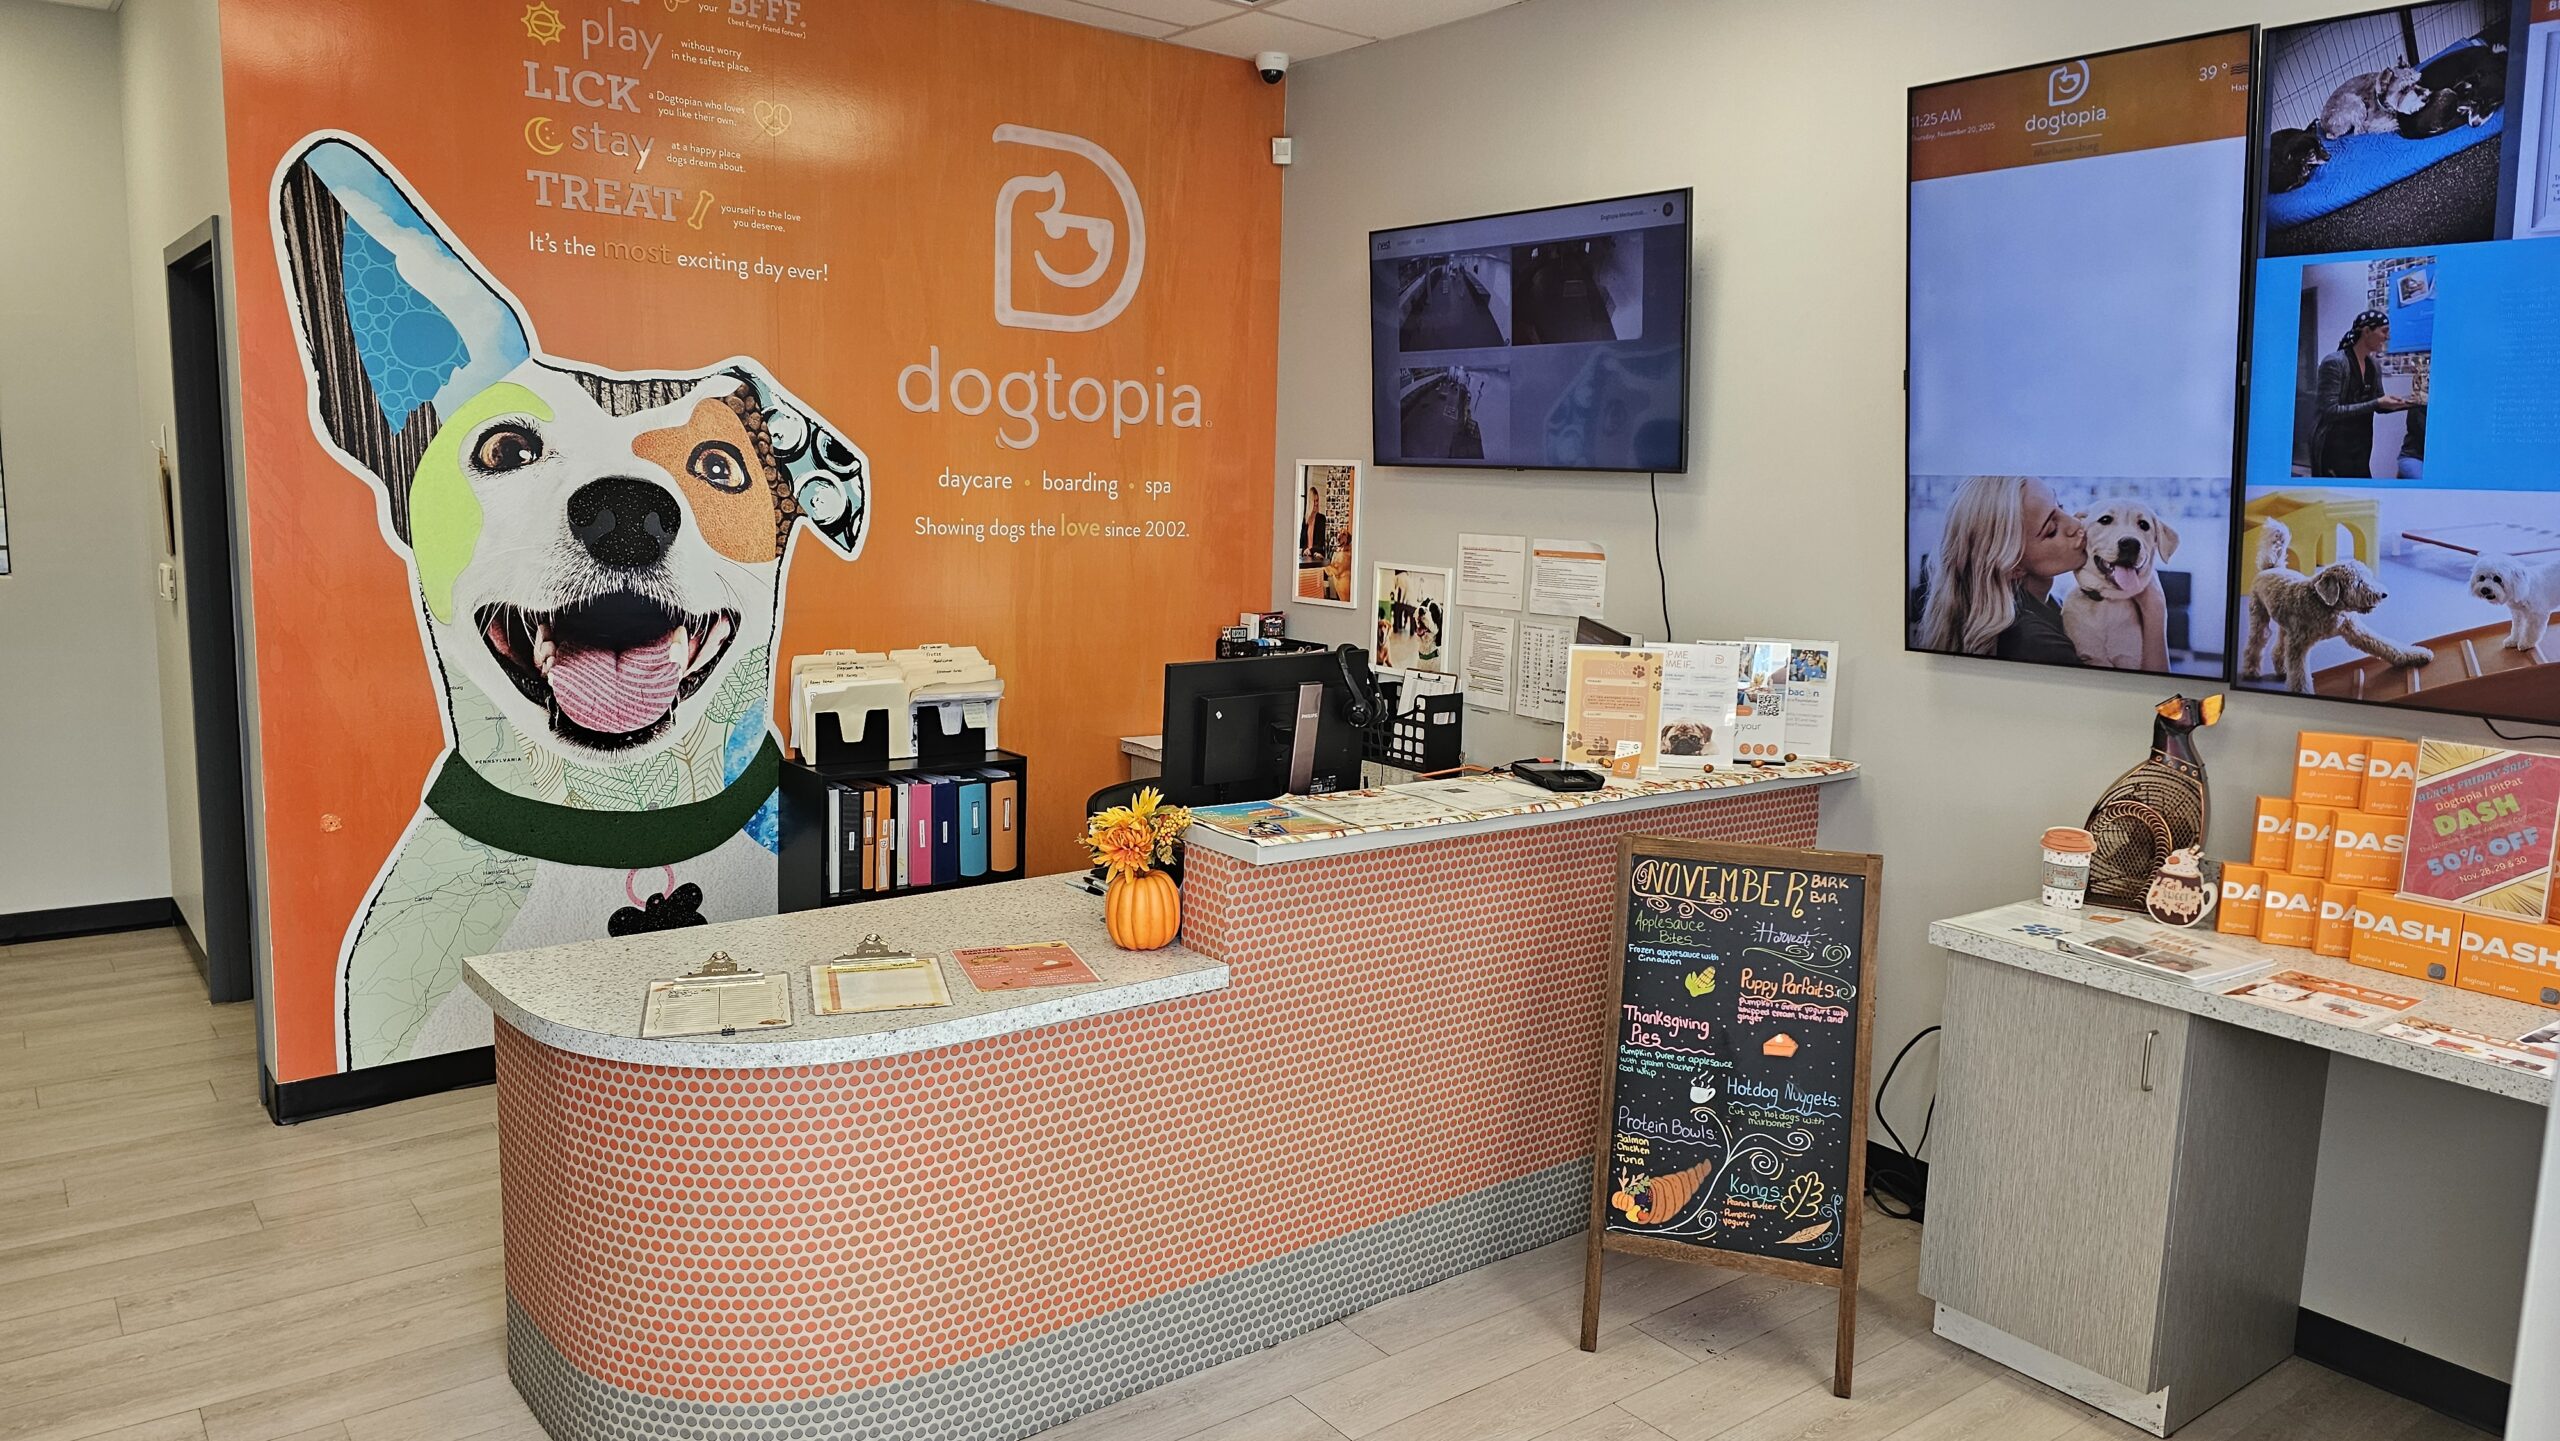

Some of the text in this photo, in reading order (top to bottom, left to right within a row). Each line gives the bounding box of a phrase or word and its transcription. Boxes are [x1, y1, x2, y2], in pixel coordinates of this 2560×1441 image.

[699, 3, 718, 13] your
[745, 20, 761, 32] furry
[762, 24, 781, 35] friend
[581, 8, 663, 70] play
[681, 39, 742, 60] without worry
[671, 50, 752, 73] in the safest place.
[523, 60, 641, 114] LICK
[656, 90, 703, 108] Dogtopian
[704, 100, 722, 110] who
[724, 102, 745, 114] loves
[658, 107, 737, 127] you like their own.
[1912, 108, 1962, 128] 11:25 AM
[2025, 105, 2107, 136] dogtopia
[571, 121, 655, 173] stay
[671, 142, 681, 151] at
[690, 143, 717, 157] happy
[718, 148, 741, 160] place
[666, 153, 747, 173] dogs dream about.
[526, 169, 683, 223] TREAT
[721, 204, 801, 221] yourself to the love
[733, 219, 786, 232] you deserve.
[529, 231, 829, 283] It's the most exciting day ever!
[897, 345, 1202, 449] dogtopia
[938, 466, 1171, 501] daycare boarding spa
[914, 513, 1190, 543] Showing dogs the love since 2002.
[1675, 651, 1689, 659] ME
[1741, 723, 1761, 731] your
[475, 757, 522, 765] PENNSYLVANIA
[2298, 748, 2366, 773] DAS
[2368, 758, 2416, 780] DA
[2417, 758, 2533, 803] BLACK FRIDAY SALE
[2435, 790, 2483, 812] Dogtopia
[2490, 777, 2523, 794] PitPat
[2257, 815, 2292, 834] DA
[2432, 793, 2521, 837] DASH
[2294, 821, 2331, 841] DA
[2334, 829, 2405, 853] DAS
[2426, 826, 2539, 877] 50% OFF
[2459, 872, 2479, 884] Nov.
[2508, 859, 2515, 868] &
[2515, 856, 2528, 866] 30
[1640, 861, 1849, 919] NOVEMBER BARK
[1809, 891, 1839, 904] BAR
[2221, 880, 2261, 901] DA
[2265, 890, 2318, 913] DA
[2320, 901, 2357, 921] DA
[1635, 909, 1706, 933] Applesauce
[2353, 909, 2451, 948] DASH
[1659, 930, 1693, 945] Bites
[1756, 922, 1814, 947] Harvest
[1628, 944, 1719, 961] Frozen applesauce with
[1637, 954, 1682, 965] Cinnamon
[2460, 930, 2560, 970] DASH
[1740, 967, 1778, 1000] Puppy
[1623, 1004, 1710, 1040] Thanksgiving
[1631, 1023, 1662, 1045] Pies
[1620, 1044, 1652, 1059] Pumpkin
[1688, 1056, 1734, 1069] applesauce
[1620, 1056, 1637, 1065] with
[1636, 1066, 1657, 1079] whip
[1727, 1076, 1779, 1108] Hotdog
[1618, 1105, 1668, 1134] Protein
[1728, 1106, 1745, 1116] Cut
[1748, 1110, 1761, 1120] up
[1802, 1117, 1825, 1126] with
[1616, 1142, 1651, 1155] Chicken
[1617, 1133, 1650, 1147] Salmon
[1616, 1153, 1645, 1166] Tuna
[1723, 1208, 1757, 1220] Pumpkin
